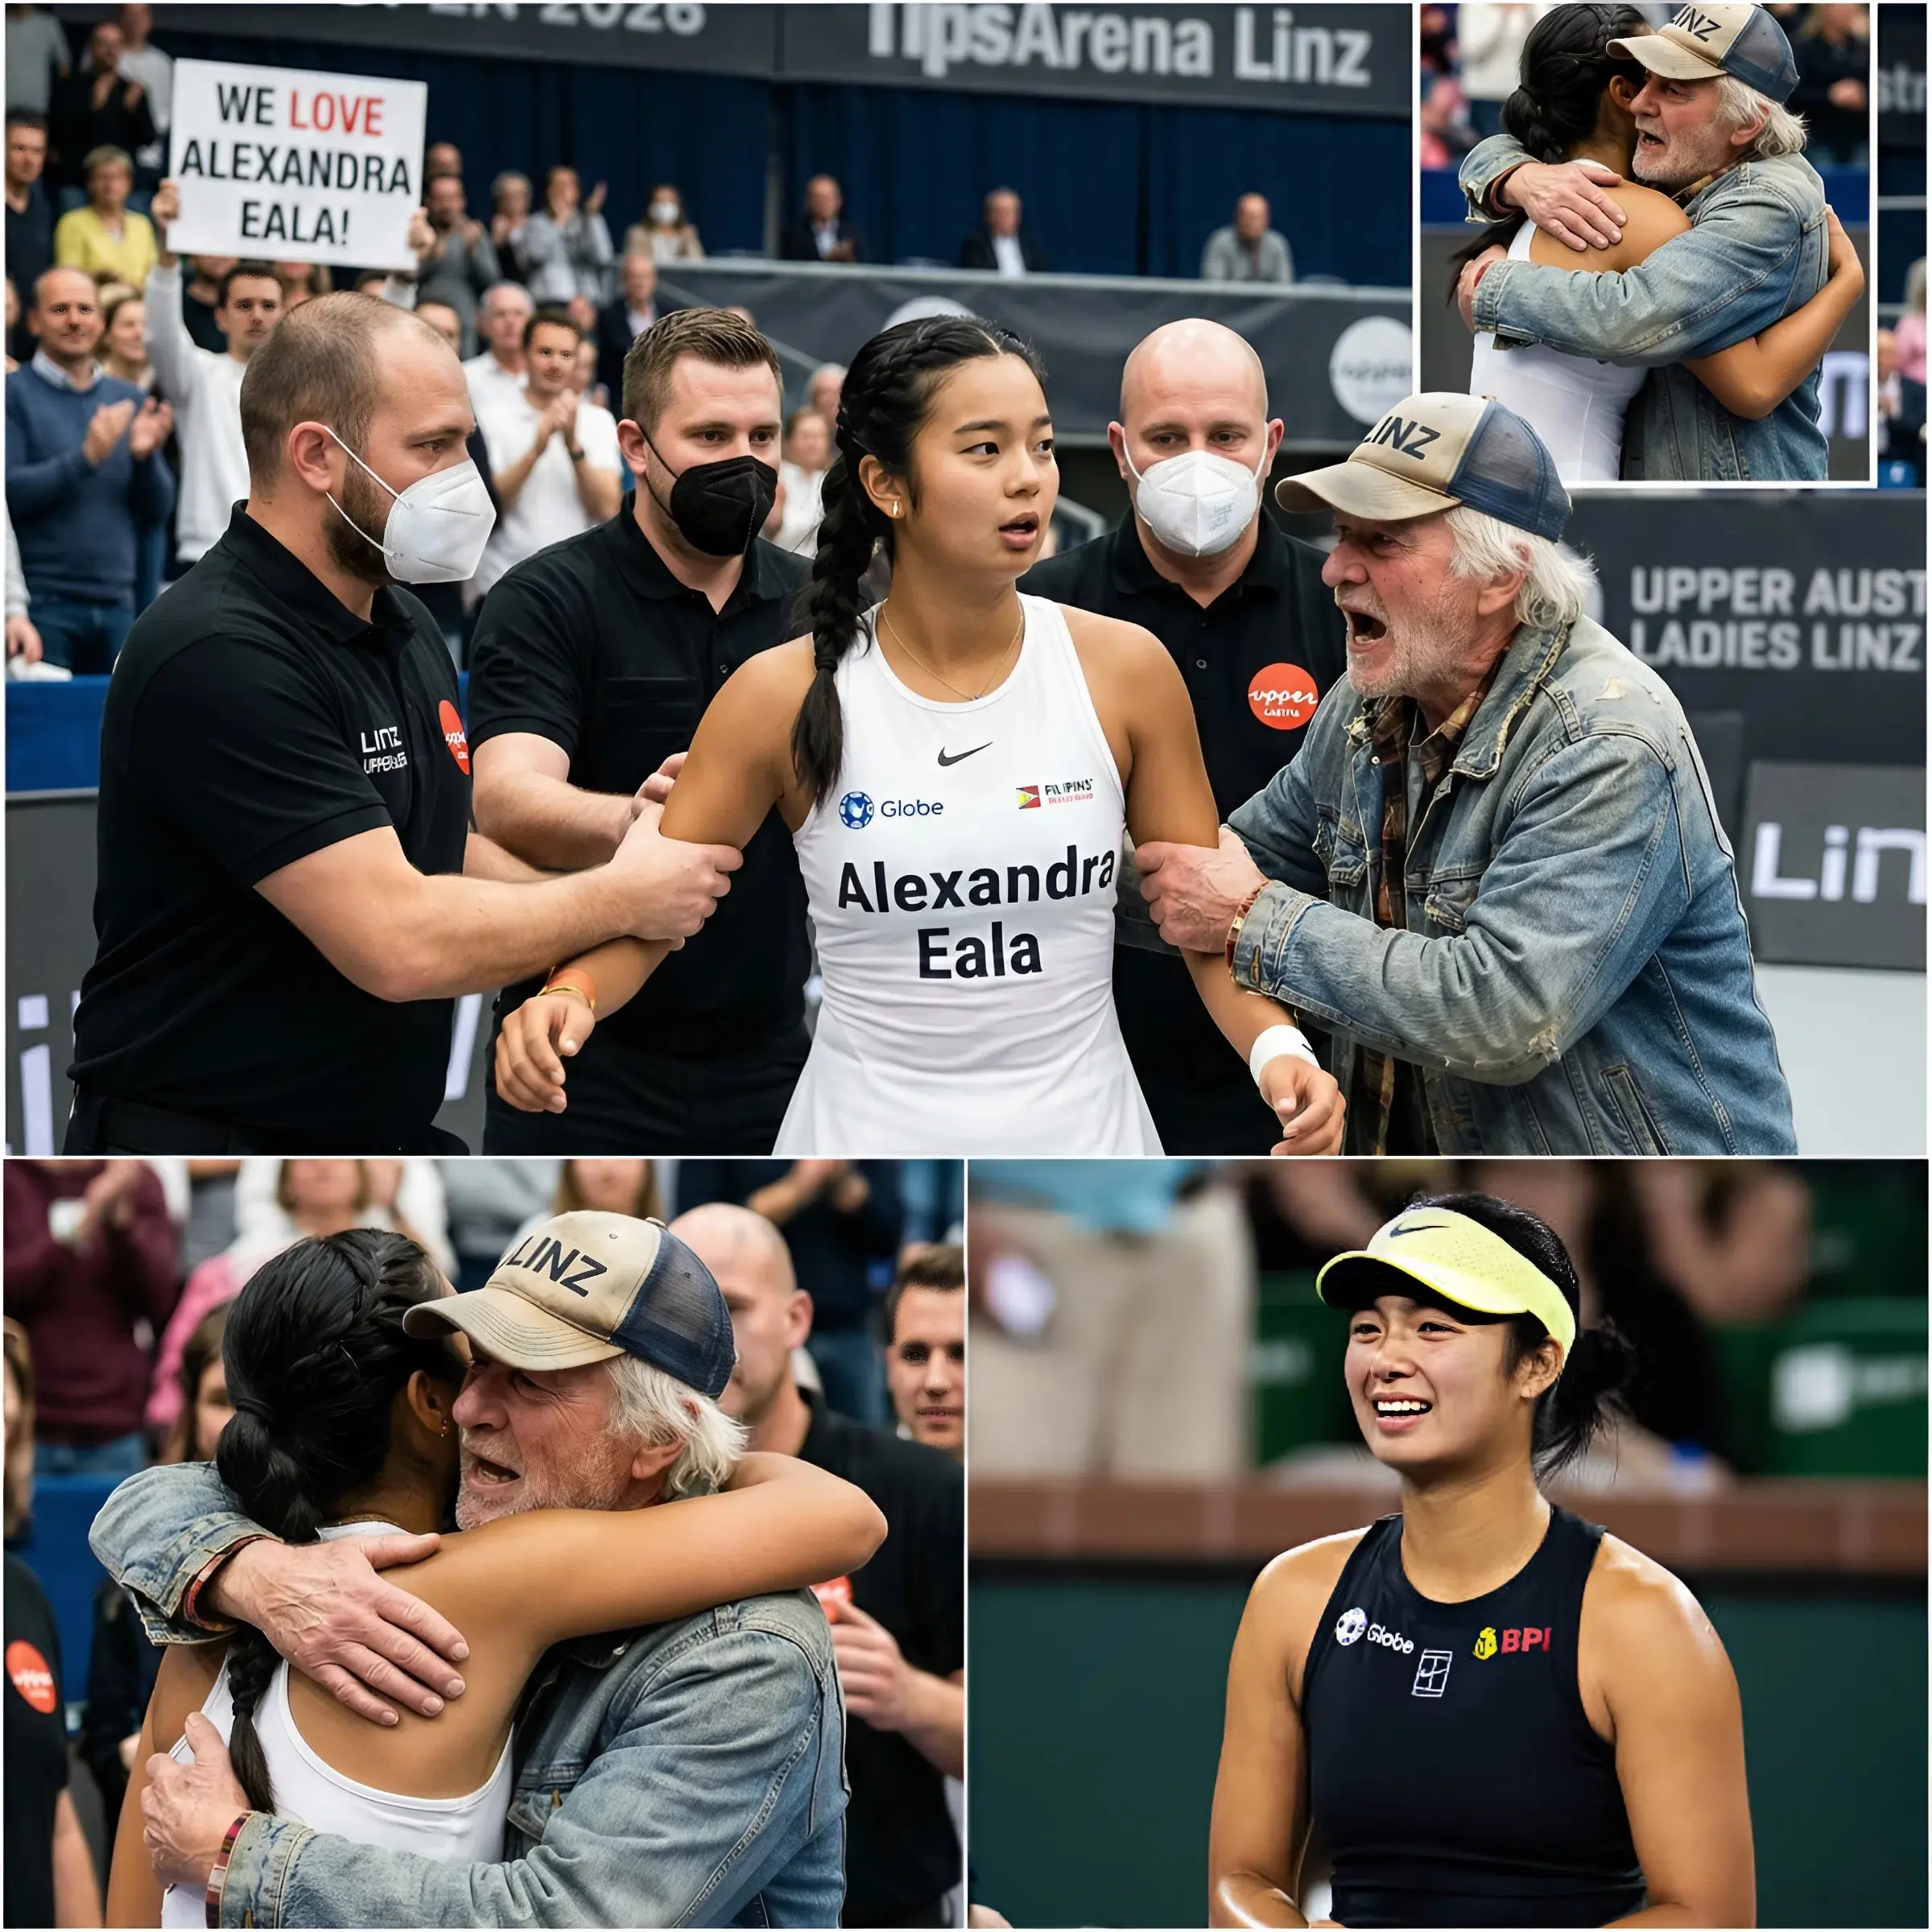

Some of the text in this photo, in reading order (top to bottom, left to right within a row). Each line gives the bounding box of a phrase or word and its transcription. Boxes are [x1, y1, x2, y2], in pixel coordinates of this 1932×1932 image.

[1234, 7, 1372, 87] Linz
[1670, 6, 1721, 42] INZ
[217, 83, 385, 136] WE LOVE
[180, 138, 411, 195] ALEXANDRA
[241, 200, 349, 245] EALA!
[1362, 416, 1442, 460] INZ
[1631, 567, 1795, 615] UPPER
[1631, 618, 1922, 671] LADIES LINZ
[1249, 690, 1319, 706] upper
[881, 799, 944, 818] Globe
[838, 844, 1115, 913] Alexandra
[1751, 821, 1927, 905] Lin
[918, 921, 1042, 979] Eala
[506, 1236, 608, 1298] LINZ
[1367, 1623, 1414, 1654] Globe
[1501, 1627, 1552, 1654] BPI
